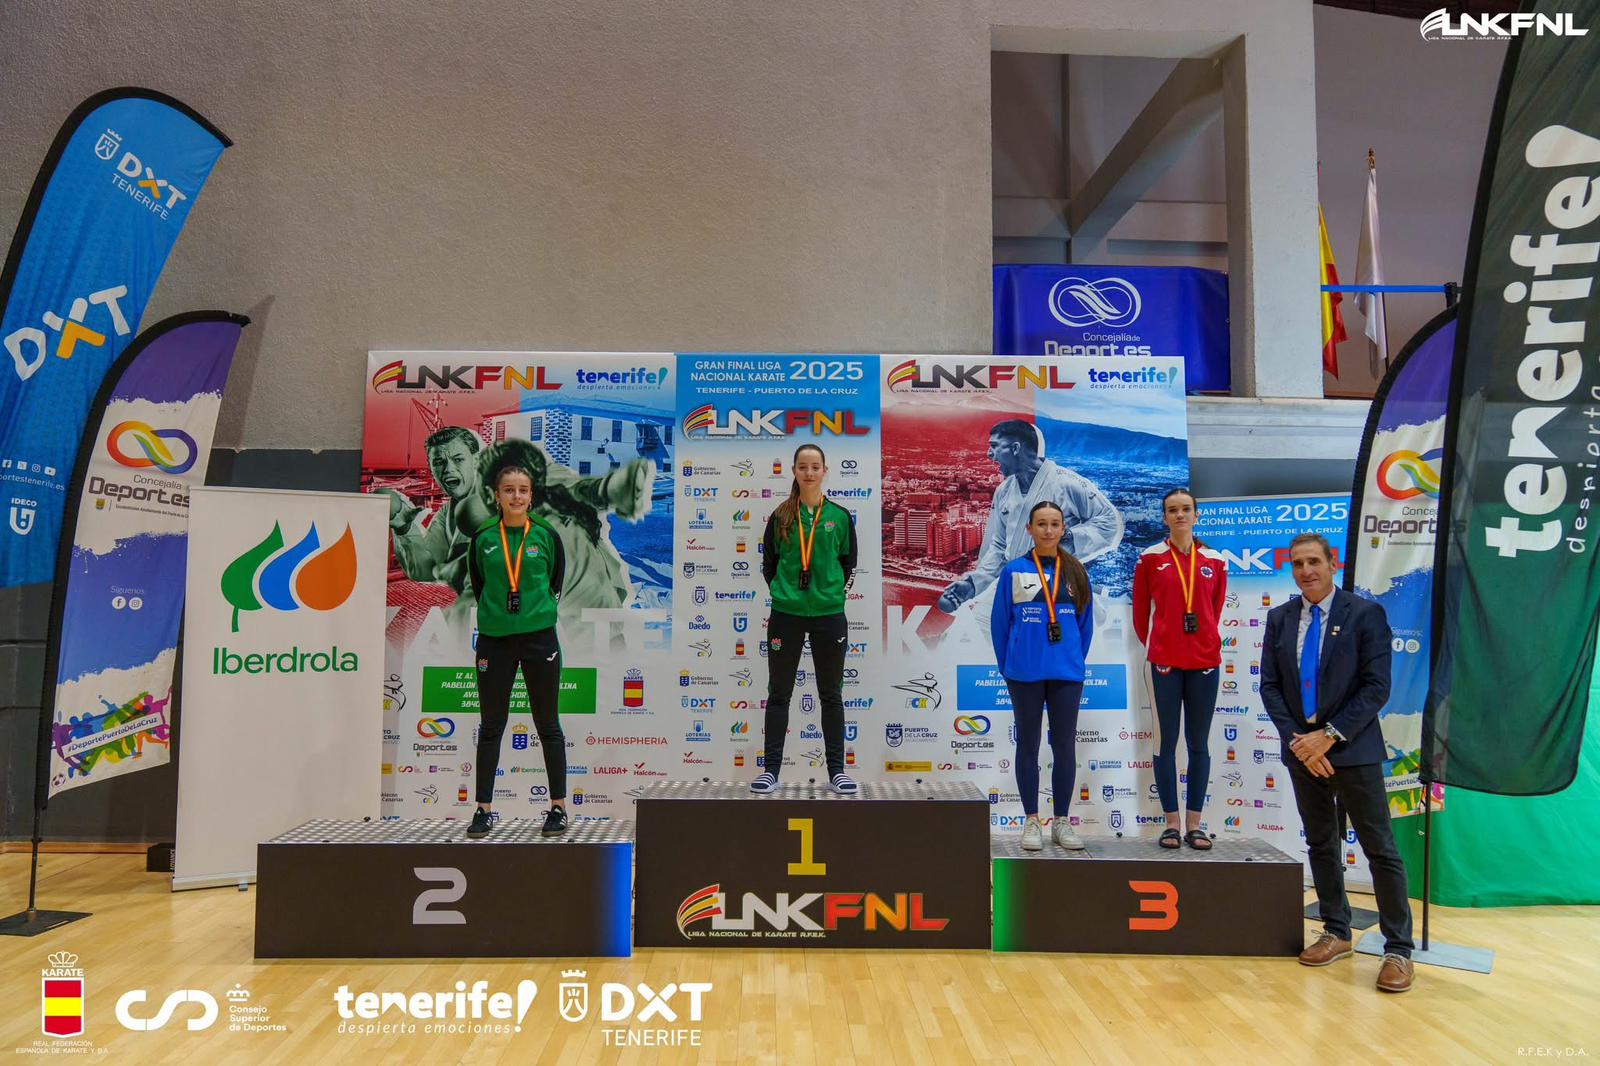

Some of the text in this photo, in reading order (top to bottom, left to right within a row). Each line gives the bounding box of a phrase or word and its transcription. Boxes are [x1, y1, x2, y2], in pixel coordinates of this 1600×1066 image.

[117, 151, 187, 210] DXT
[111, 172, 170, 221] TENERIFE
[3, 284, 132, 382] DXT
[695, 361, 781, 370] GRAN FINAL LIGA
[789, 361, 864, 380] 2025
[690, 372, 785, 382] NACIONAL KARATE
[133, 474, 182, 490] Concejalía
[694, 488, 718, 497] DXT
[11, 497, 38, 507] IDECO
[1219, 507, 1244, 515] FINAL
[1246, 506, 1268, 514] LIGA
[1276, 502, 1348, 522] 2025
[1193, 516, 1272, 526] ACIONAL KARATE
[689, 622, 711, 630] Daedo
[213, 646, 359, 674] Iberdrola
[691, 699, 716, 707] DXT
[1216, 706, 1249, 714] enerife!
[67, 717, 158, 752] #DeportePuertoDeLaCruz
[800, 731, 822, 739] Daedo
[598, 737, 668, 745] HEMISPHERIA
[951, 741, 994, 750] Deportes
[413, 743, 457, 752] Deportes
[1128, 761, 1155, 769] LALIGA
[593, 767, 628, 775] LALIGA+
[1001, 816, 1025, 826] DXT
[1136, 815, 1165, 824] teneri
[788, 818, 826, 875] 1
[413, 867, 467, 924] 2
[1128, 880, 1178, 930] 3
